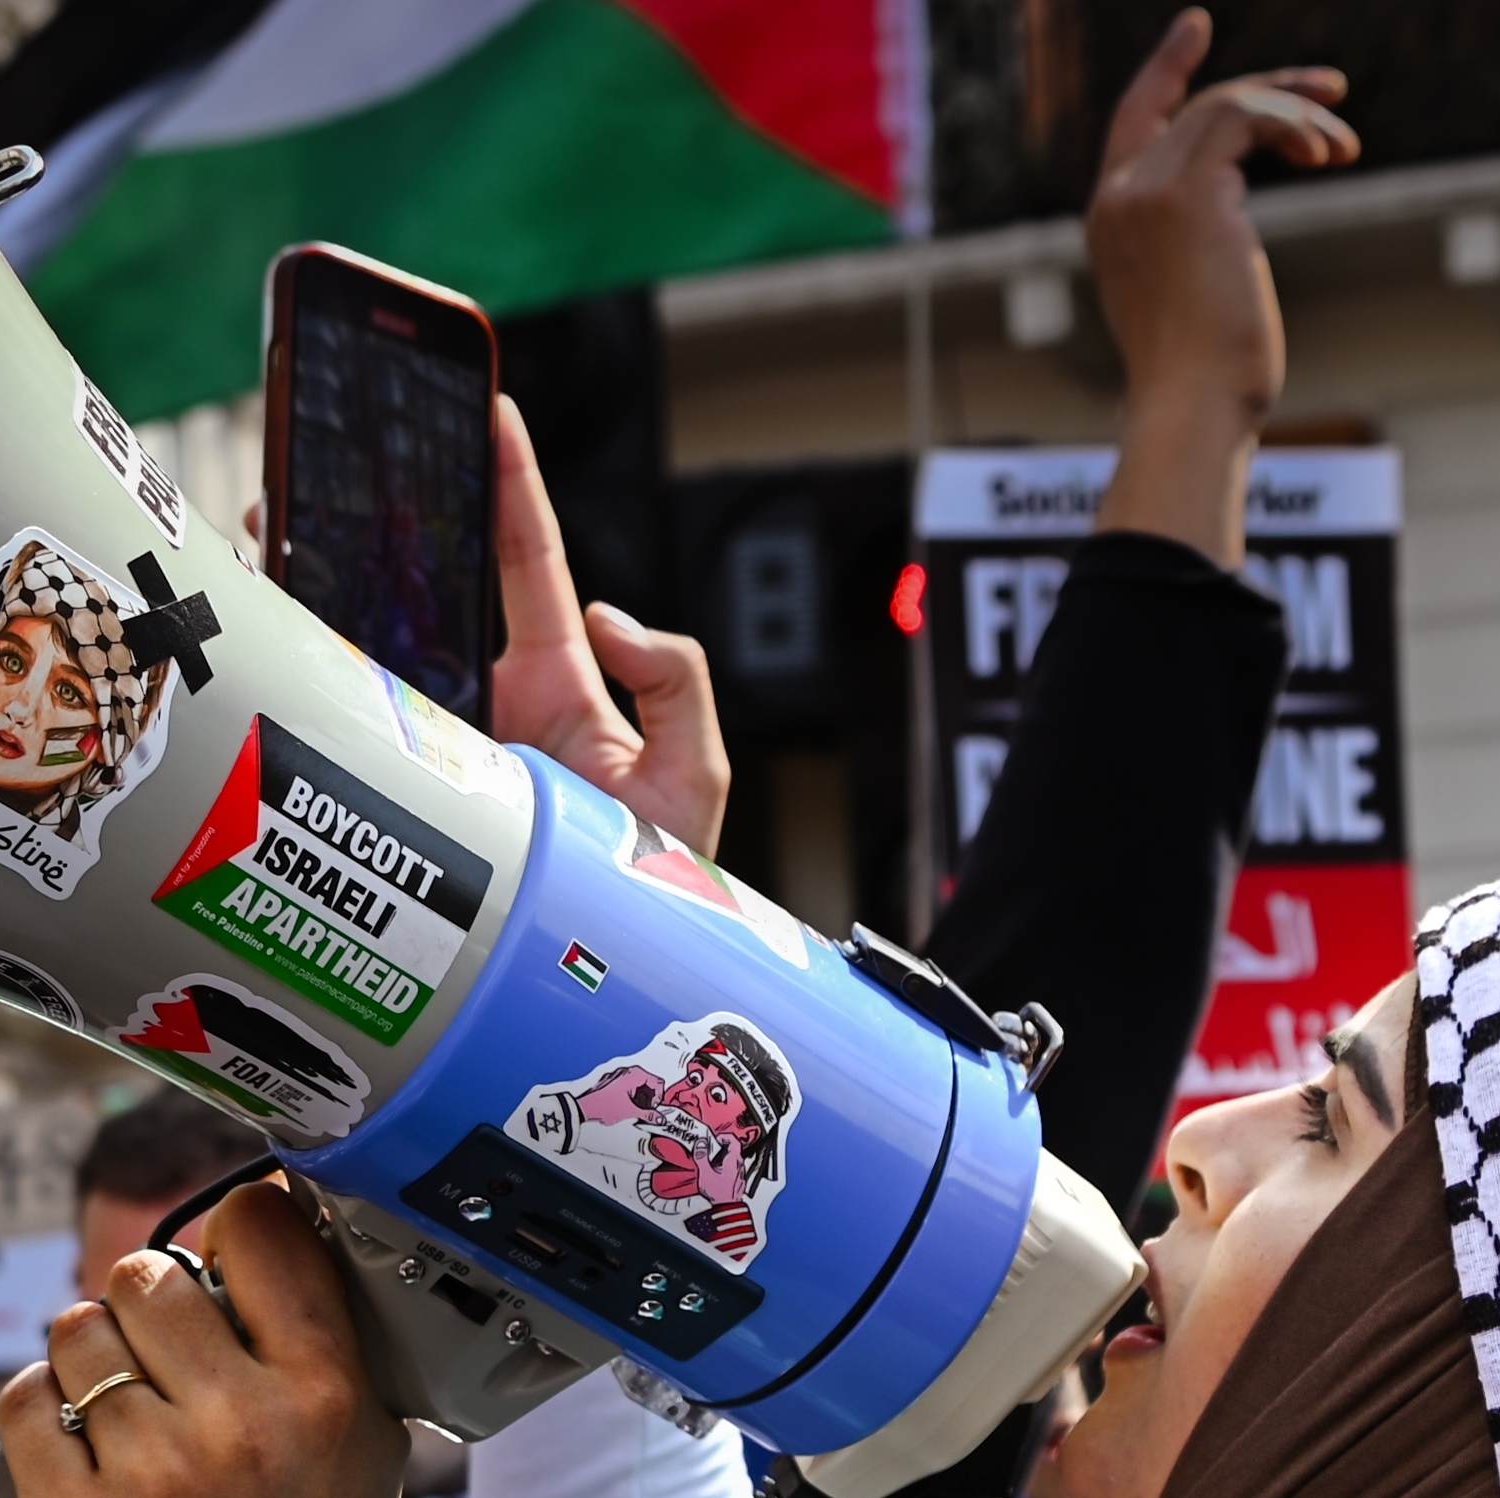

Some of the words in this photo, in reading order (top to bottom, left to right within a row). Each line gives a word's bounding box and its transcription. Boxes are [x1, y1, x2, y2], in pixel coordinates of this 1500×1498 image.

[282, 775, 445, 900] BOYCOTT
[252, 827, 397, 939] ISRAELI
[192, 901, 217, 922] Free
[216, 916, 265, 951] Palestine
[273, 952, 395, 1033] www.palestinecampaign.org
[220, 878, 419, 1014] APARTHEID
[220, 1055, 272, 1089] FOA
[727, 1058, 748, 1082] FREE
[746, 1080, 776, 1125] PALESTINE
[439, 1183, 462, 1200] M
[416, 1241, 471, 1277] USB/SD
[508, 1248, 542, 1271] USB
[496, 1288, 526, 1310] MIC
